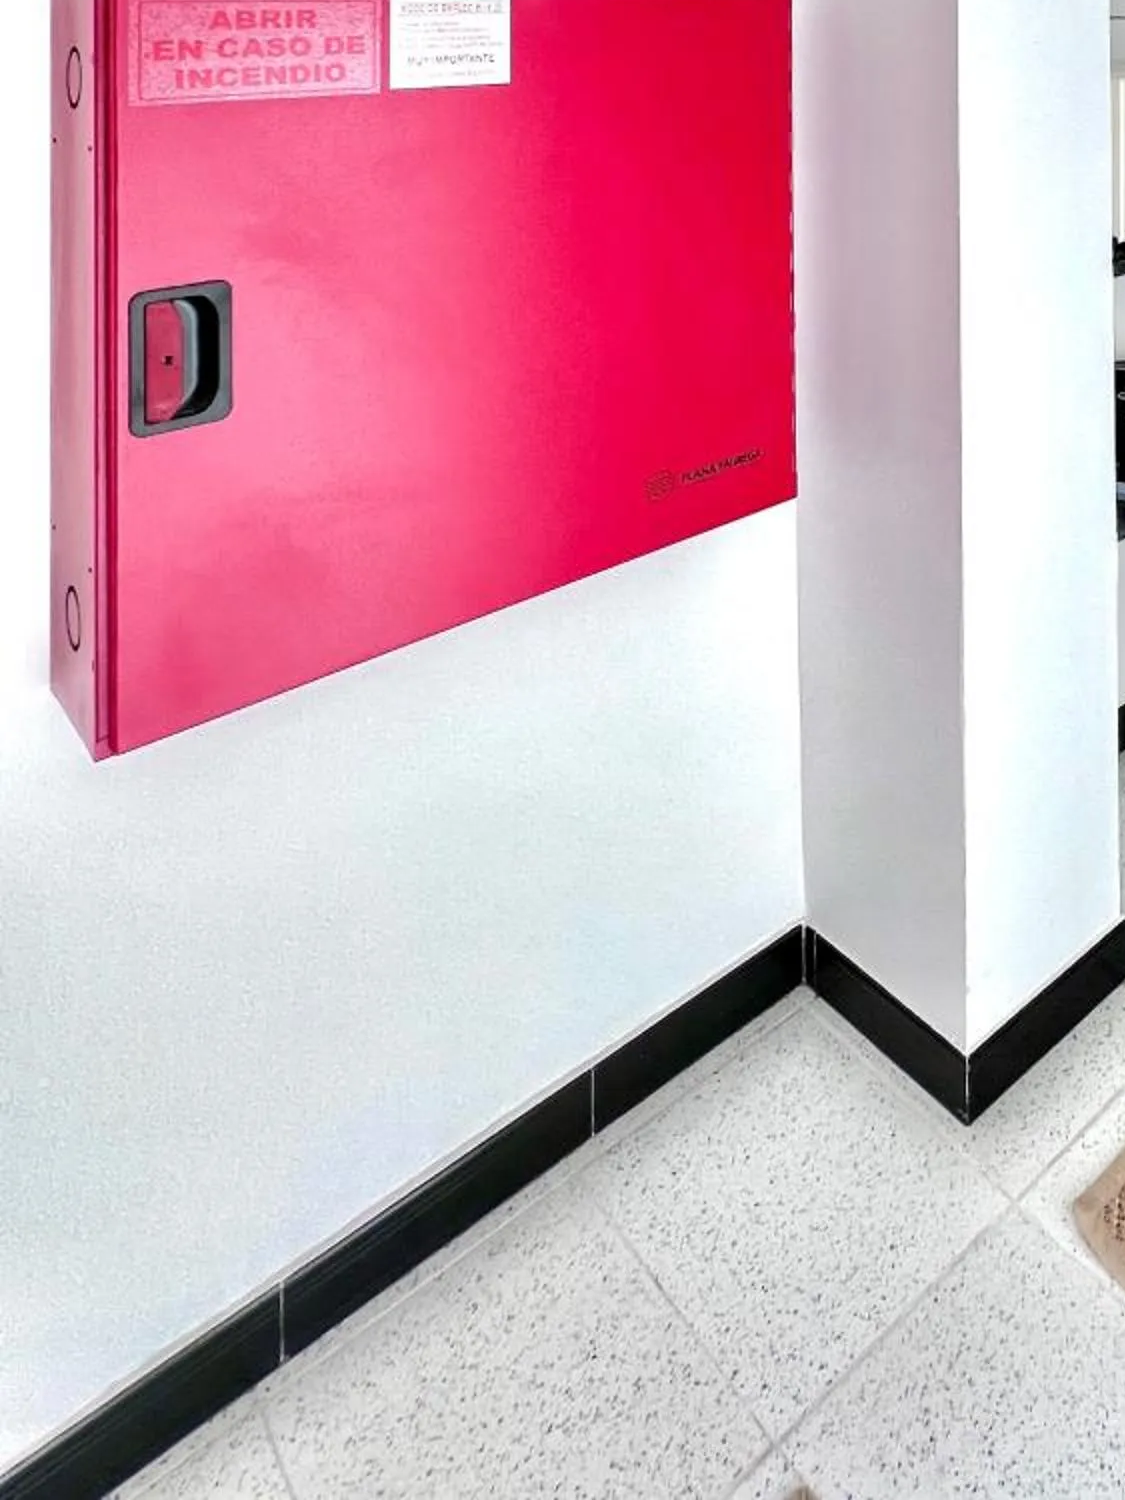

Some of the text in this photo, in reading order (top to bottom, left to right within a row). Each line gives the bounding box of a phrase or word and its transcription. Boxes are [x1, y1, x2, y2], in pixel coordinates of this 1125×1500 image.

[208, 8, 318, 31] ABRIR
[152, 35, 367, 62] EN CASO DE
[174, 61, 347, 90] INCENDIO
